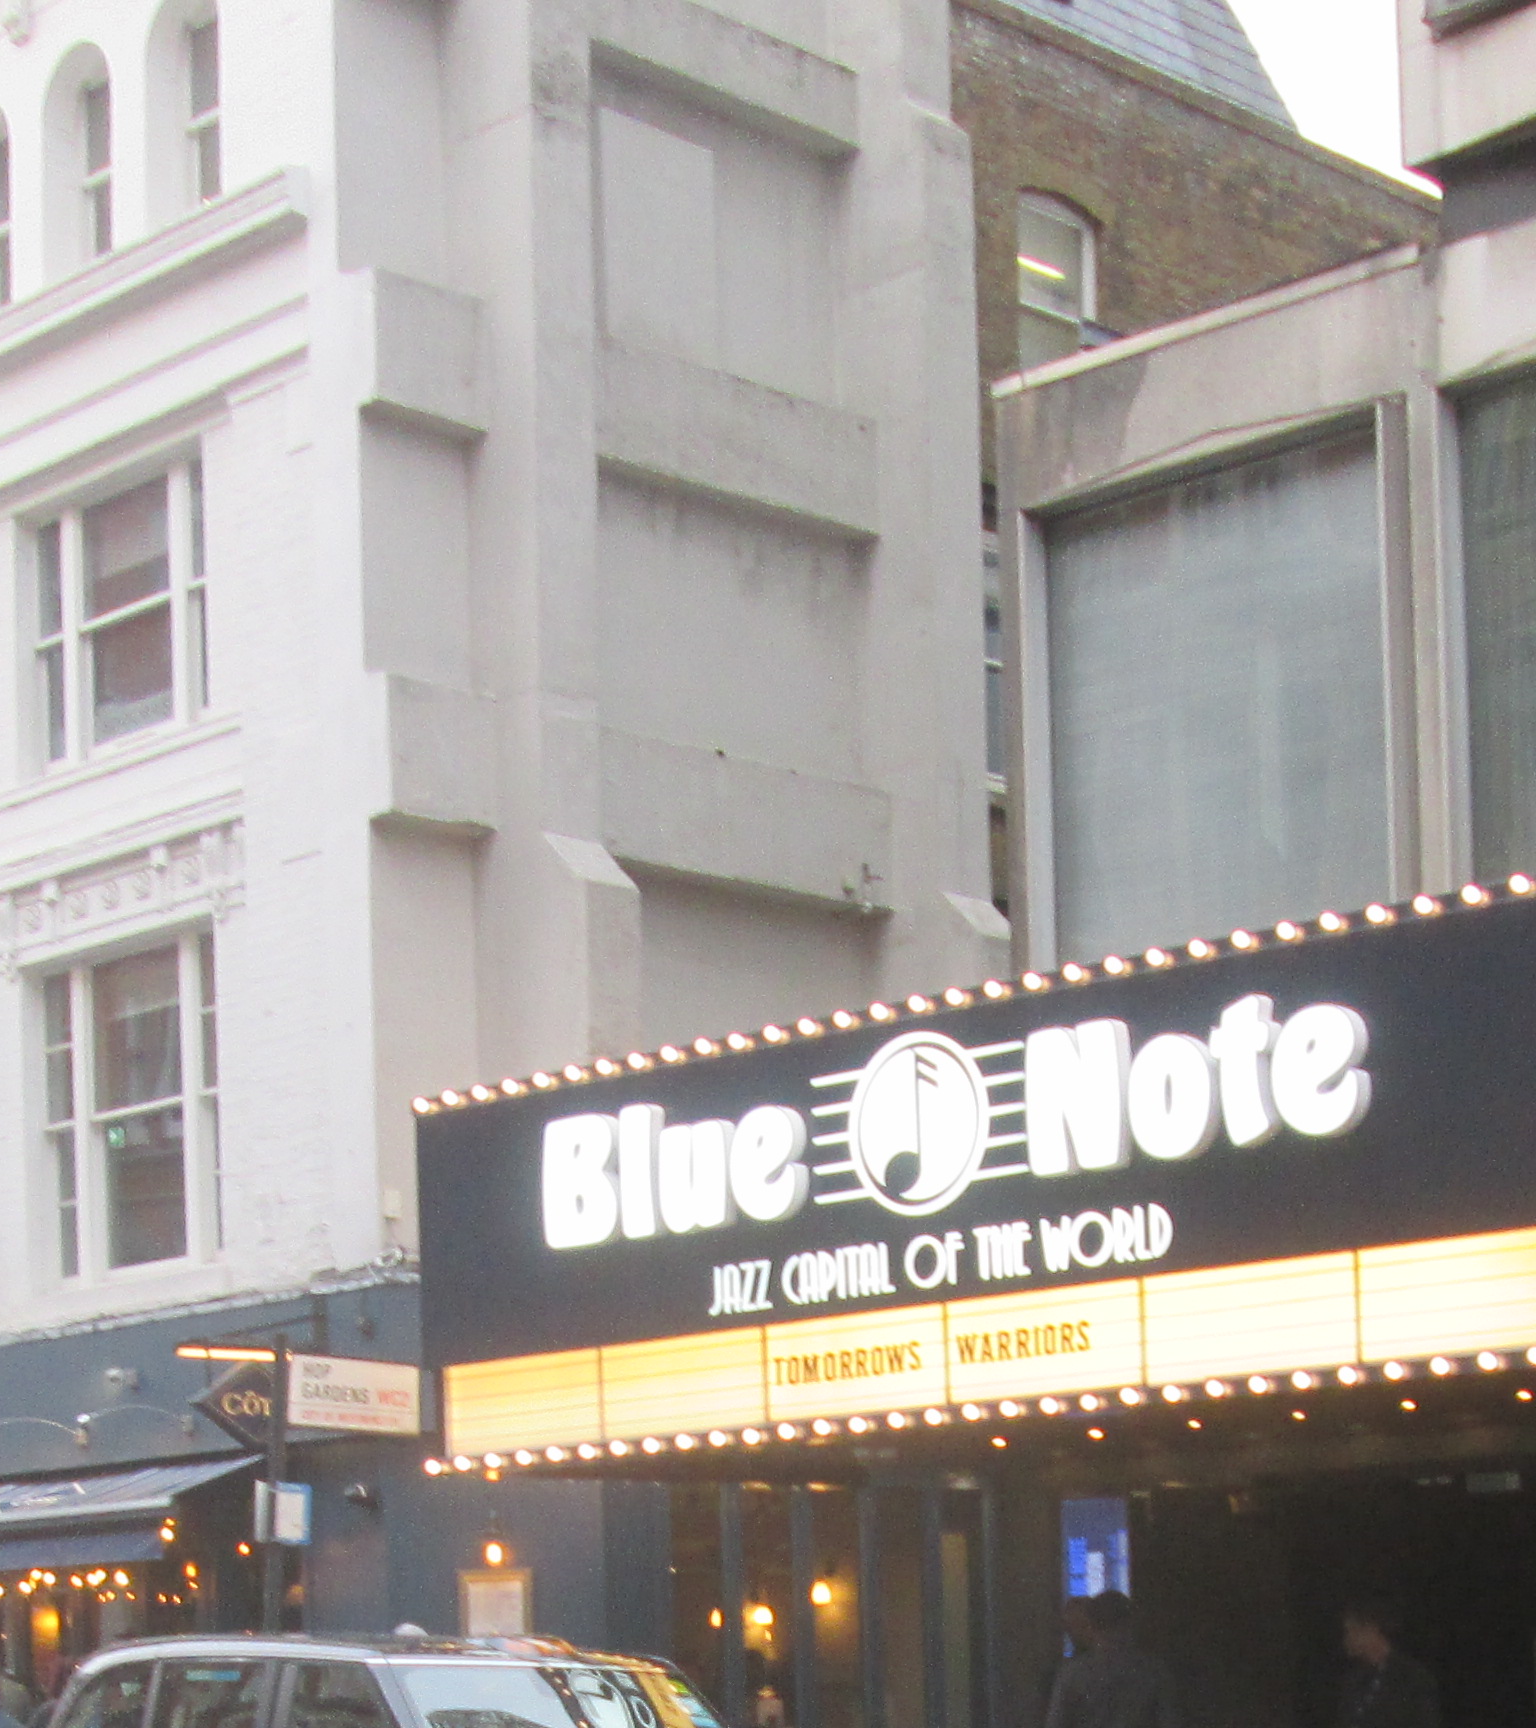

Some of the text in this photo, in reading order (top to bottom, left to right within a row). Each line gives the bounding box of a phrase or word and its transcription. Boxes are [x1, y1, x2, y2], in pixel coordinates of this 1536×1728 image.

[542, 992, 1372, 1250] Blue Note
[708, 1202, 1174, 1317] JAZZ CAPITAL OF THE WORLD
[301, 1361, 332, 1379] HOP
[772, 1320, 1091, 1387] TOMORROWS WARRIORS
[221, 1389, 273, 1417] CÔT
[300, 1381, 371, 1405] GARDENS
